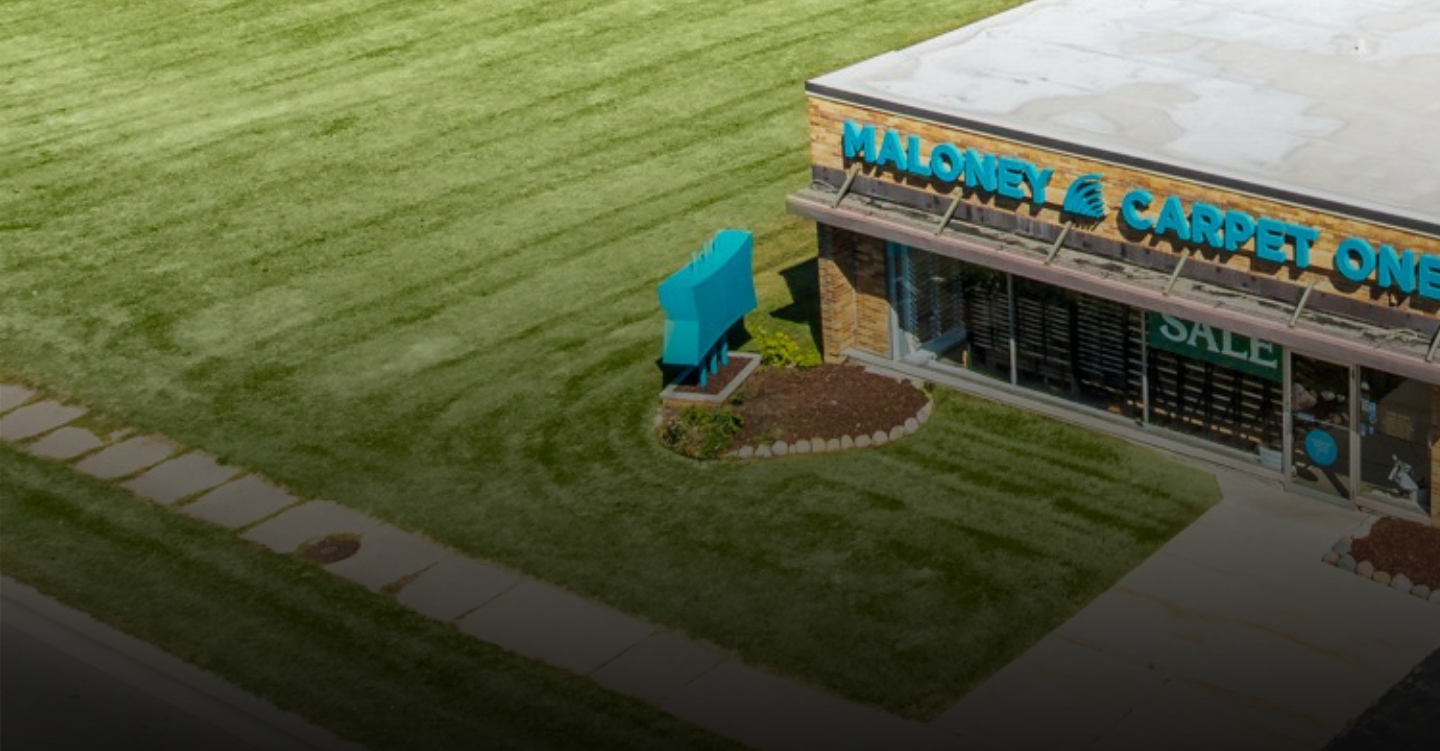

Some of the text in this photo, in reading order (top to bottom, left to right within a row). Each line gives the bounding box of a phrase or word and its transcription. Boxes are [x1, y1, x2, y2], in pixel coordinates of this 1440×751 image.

[843, 119, 1053, 204] MALONEY
[1121, 188, 1319, 268] CARPET
[1159, 312, 1278, 369] SALE
